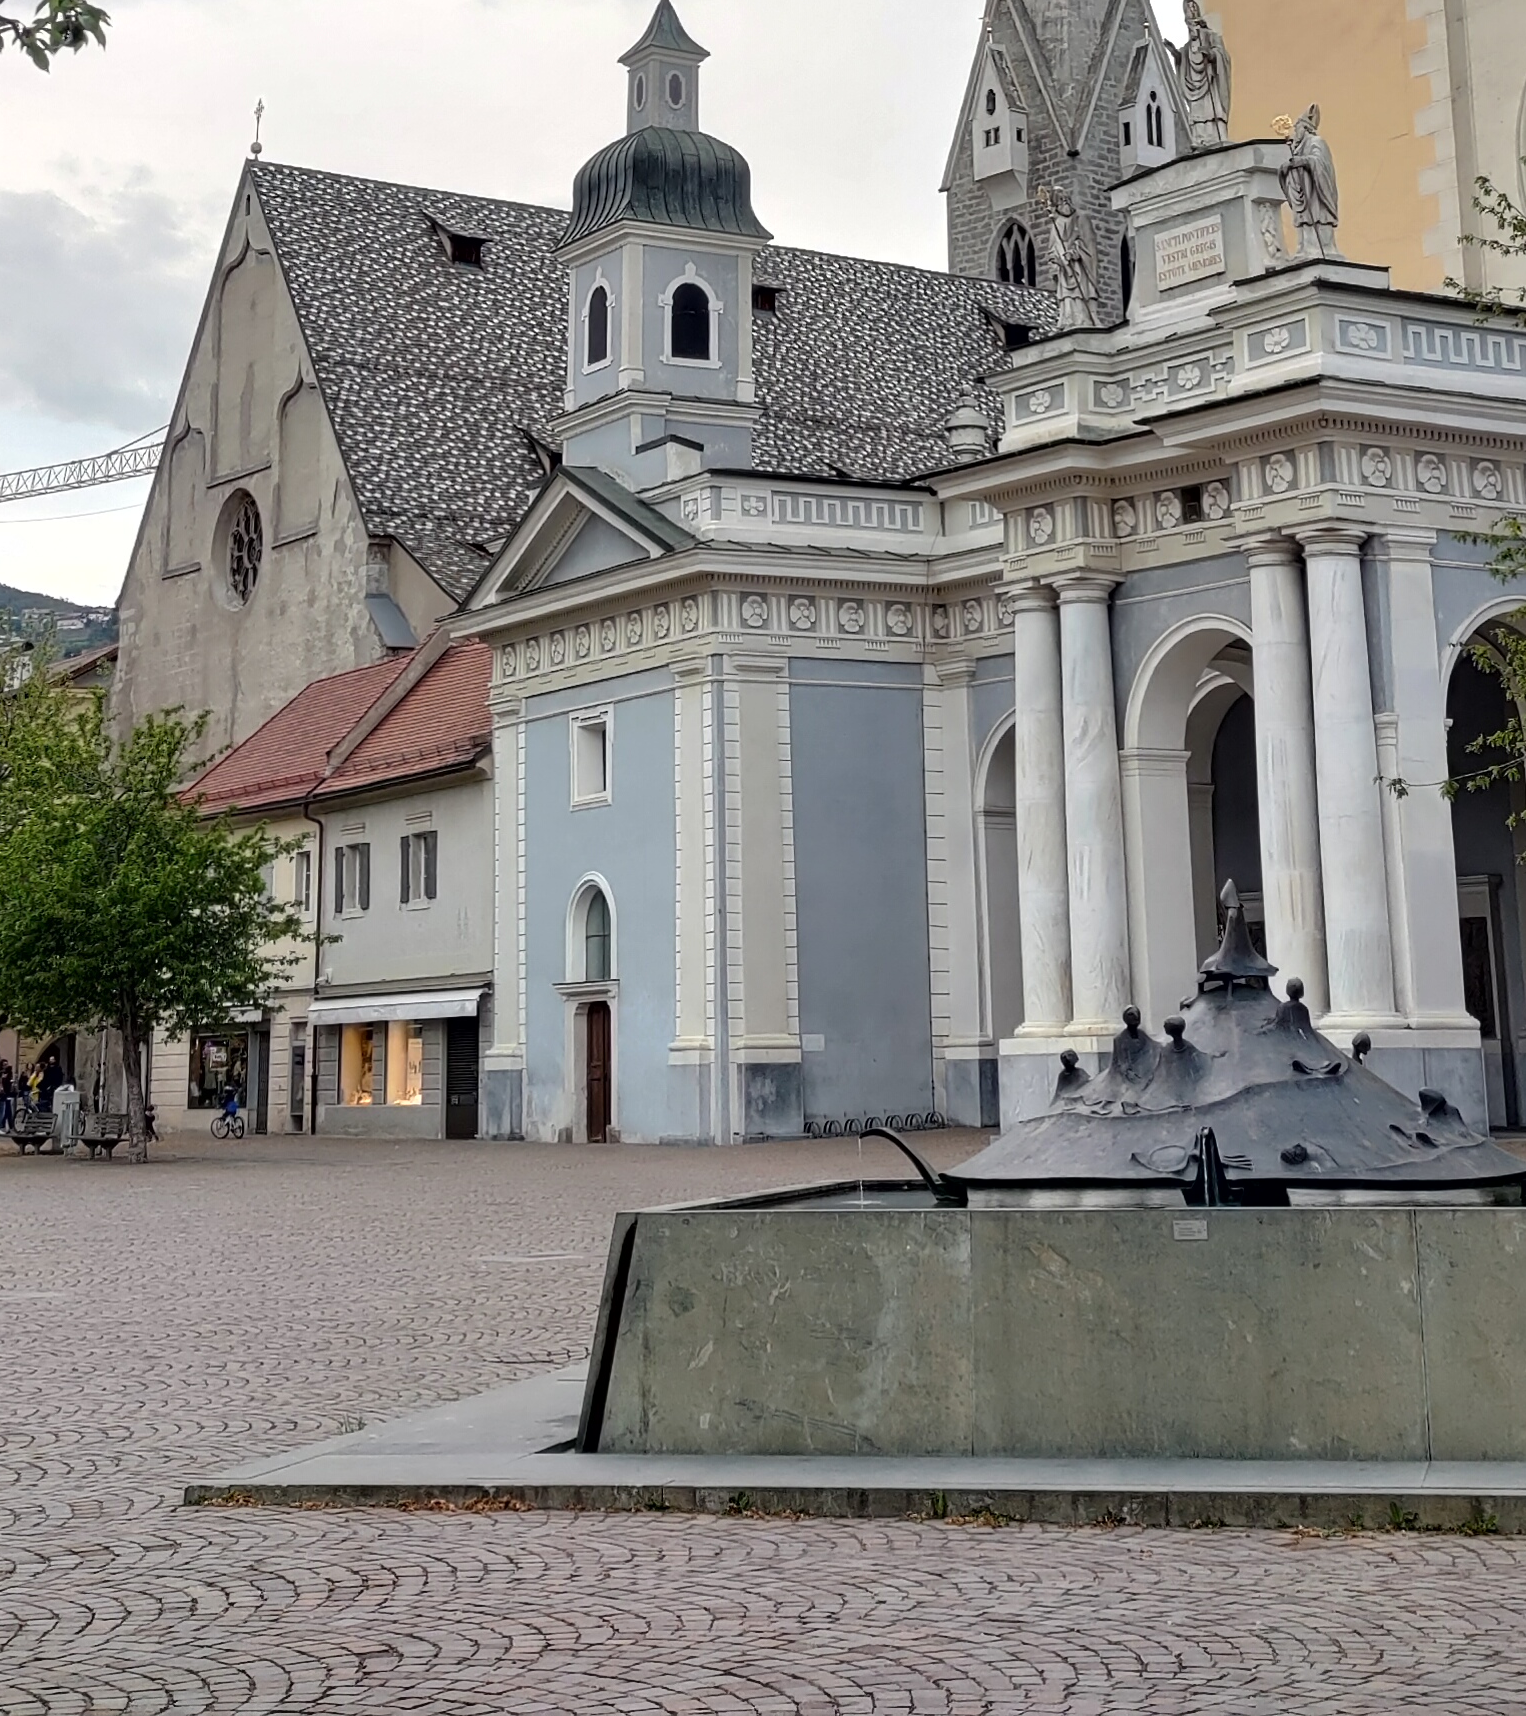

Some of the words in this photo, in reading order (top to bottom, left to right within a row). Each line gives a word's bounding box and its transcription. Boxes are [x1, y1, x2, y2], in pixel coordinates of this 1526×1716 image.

[1182, 224, 1220, 244] PONTIFICES
[1161, 248, 1188, 265] VESTRI
[1190, 239, 1217, 256] GREGIS
